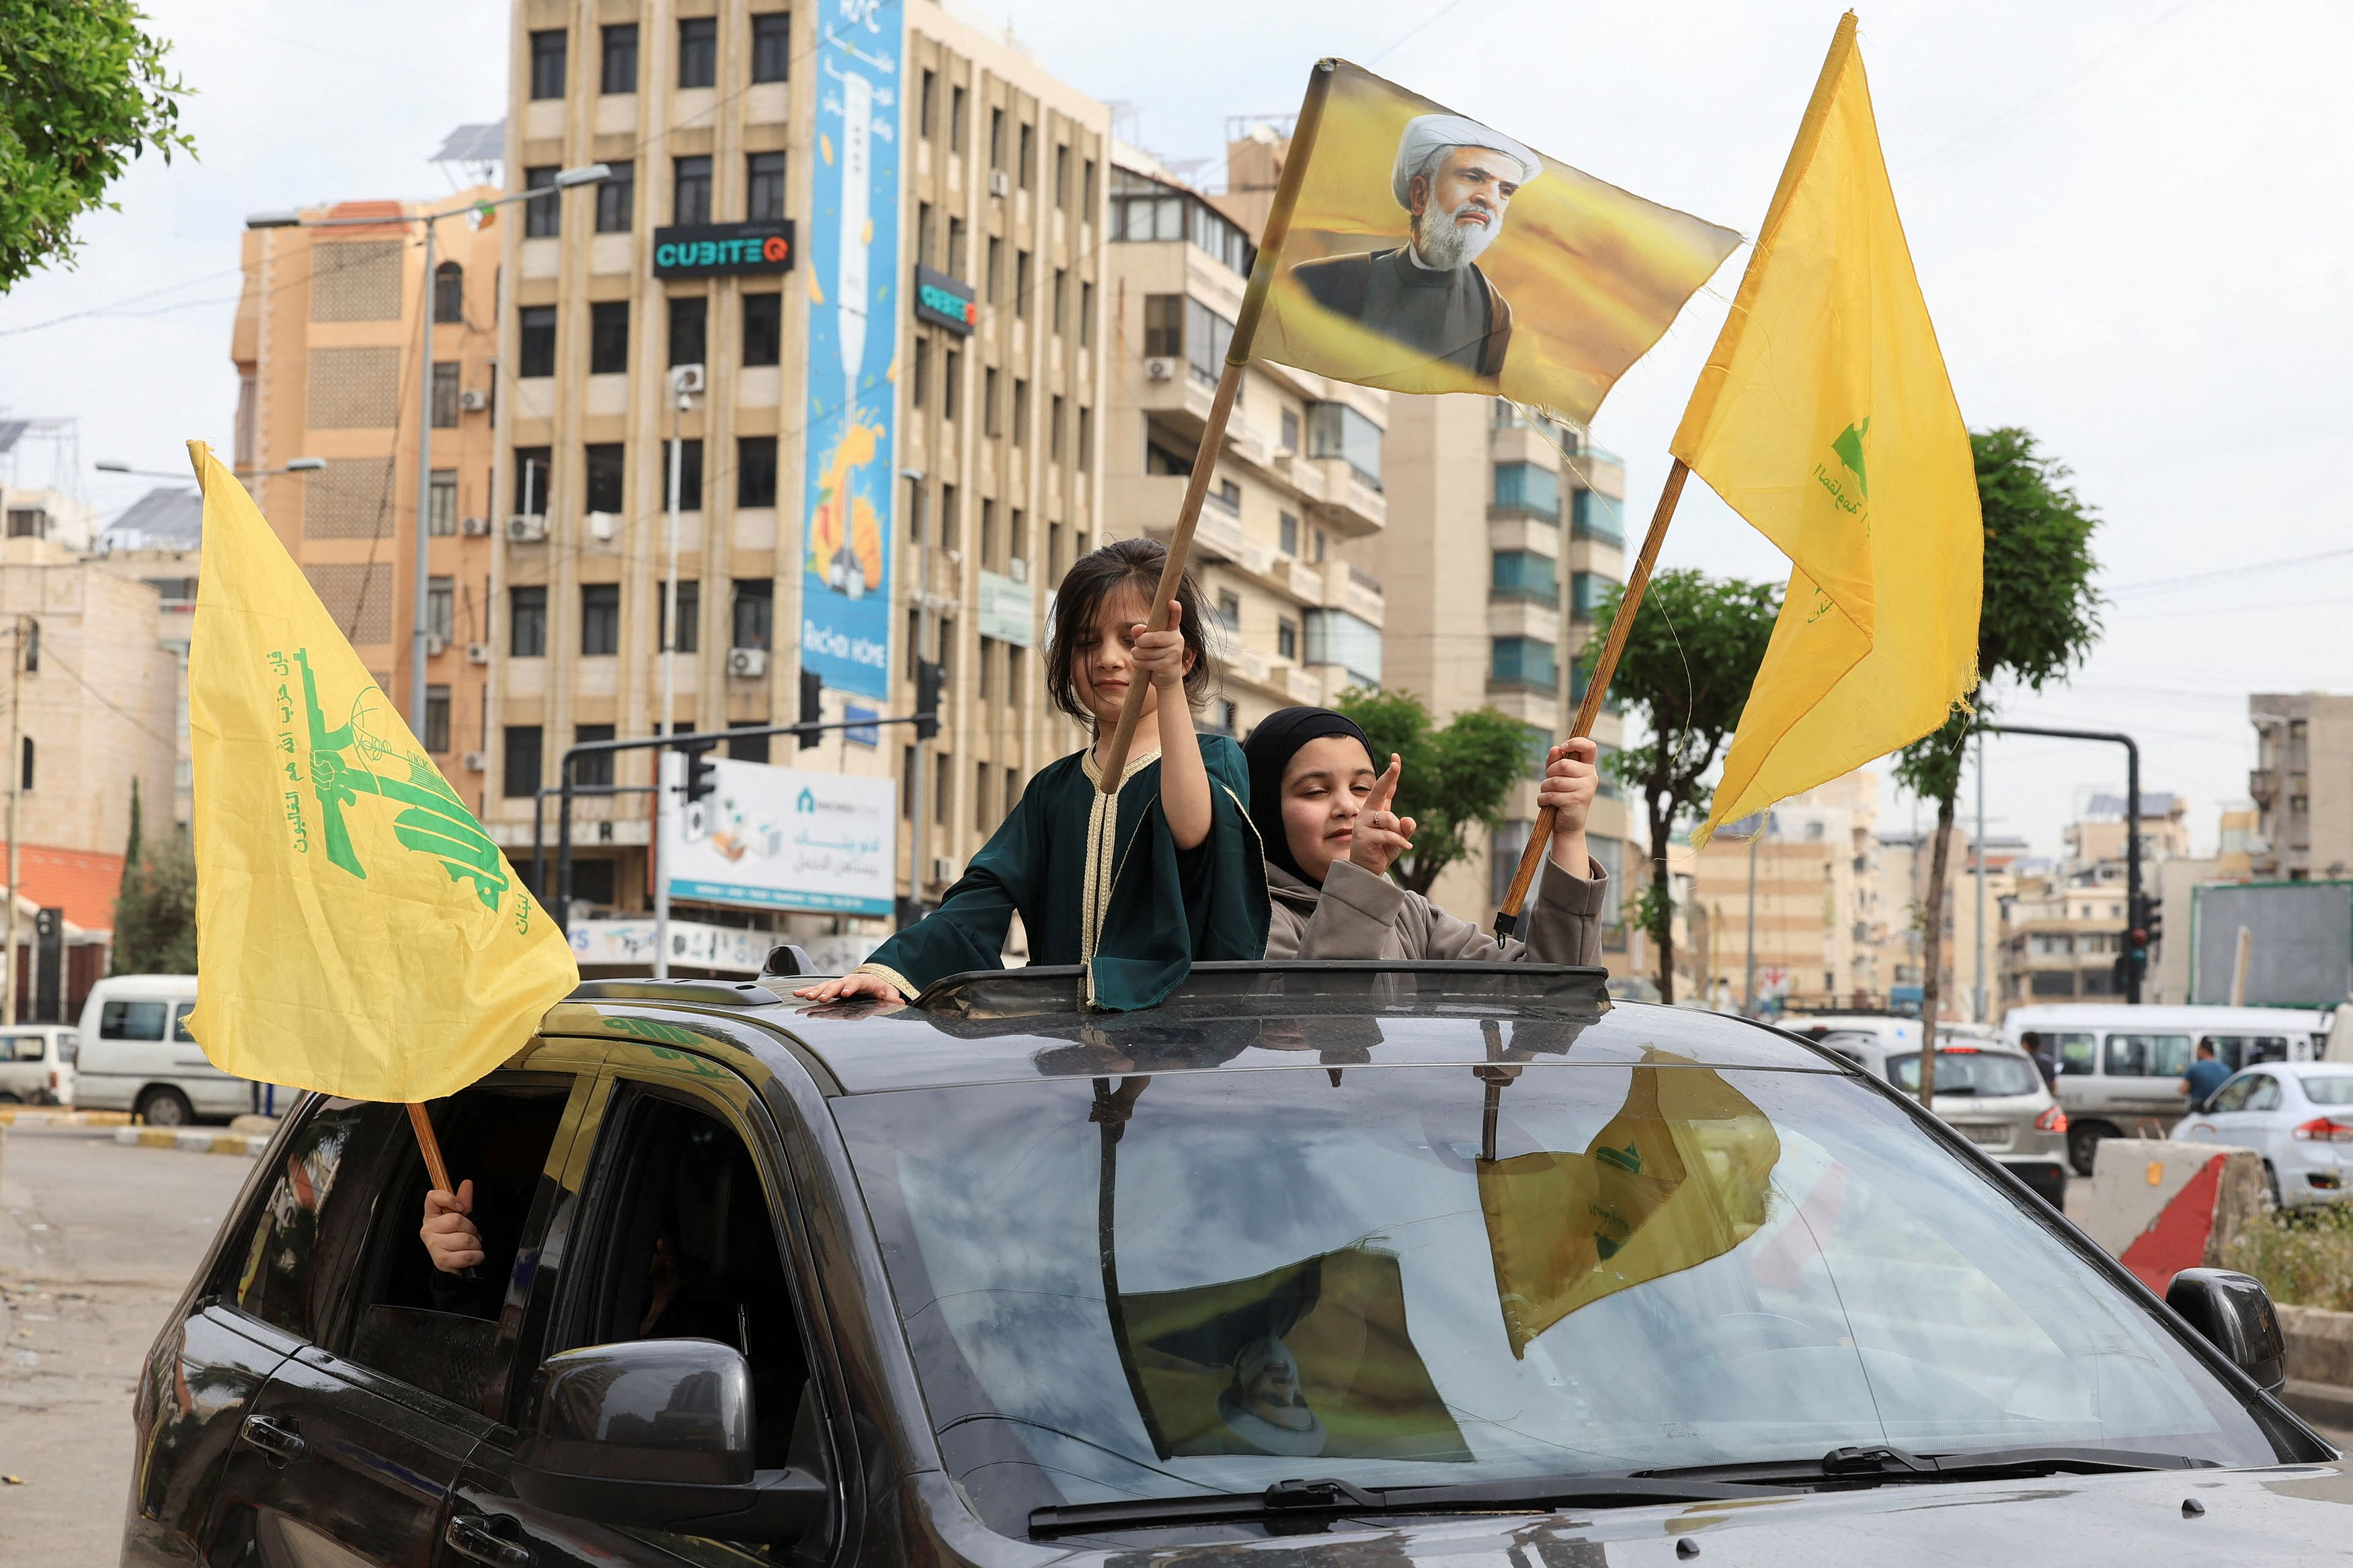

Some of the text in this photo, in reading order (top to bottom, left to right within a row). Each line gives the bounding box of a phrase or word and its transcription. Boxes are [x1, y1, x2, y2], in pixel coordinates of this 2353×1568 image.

[277, 684, 294, 723] حزب
[276, 732, 294, 753] الله
[284, 762, 305, 781] هم
[285, 792, 307, 853] الغالبون
[516, 893, 531, 936] لبنان
